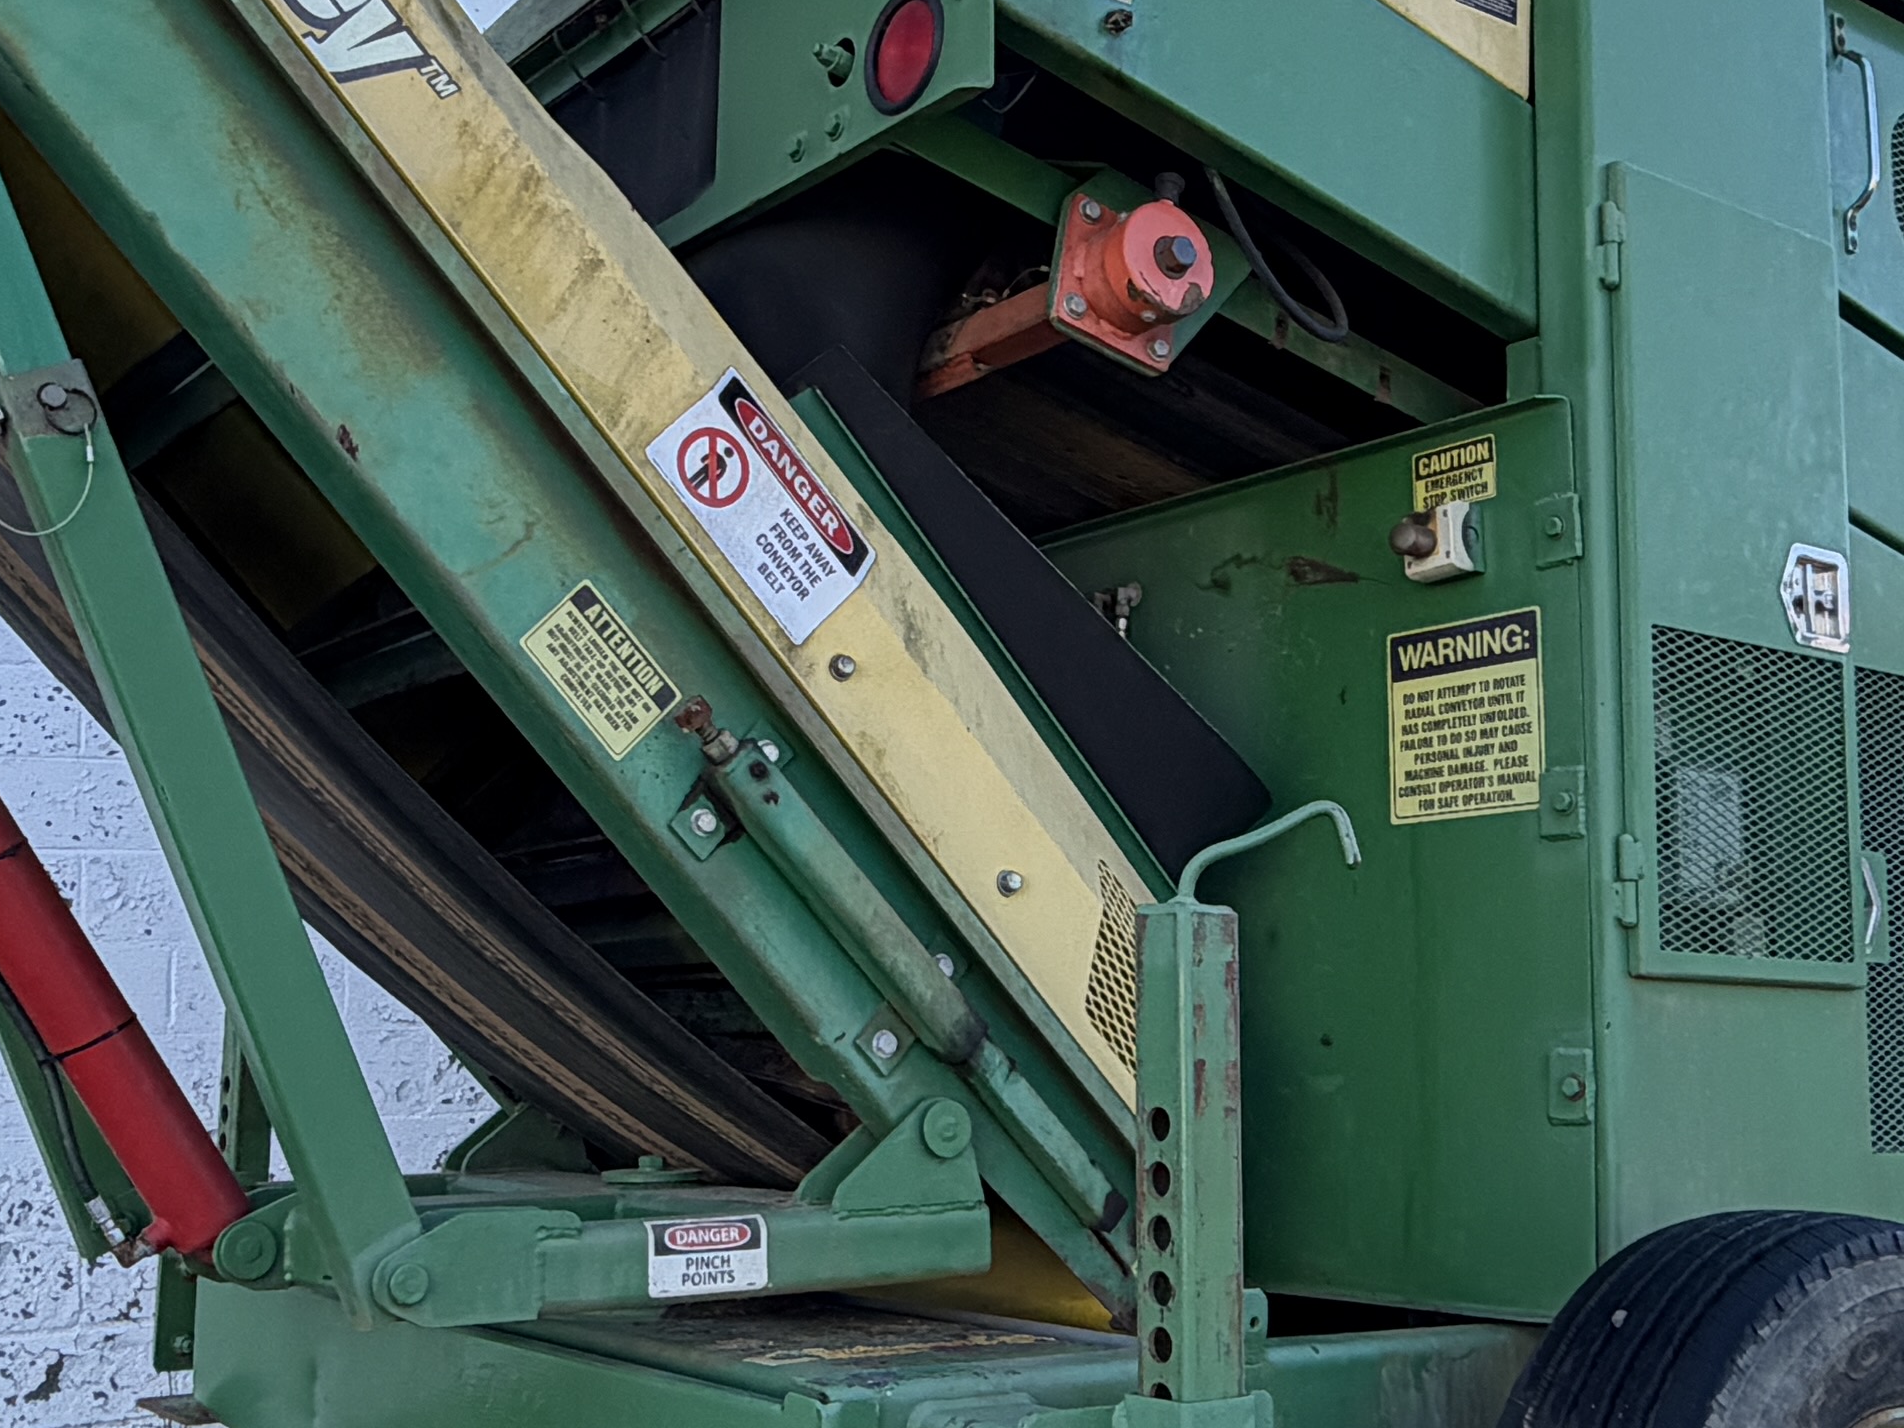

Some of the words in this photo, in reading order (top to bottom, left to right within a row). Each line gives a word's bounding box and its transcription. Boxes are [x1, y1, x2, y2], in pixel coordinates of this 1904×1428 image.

[1419, 441, 1490, 476] CAUTION
[749, 416, 839, 537] DANGER
[1425, 467, 1483, 493] EMERGENCY
[1423, 492, 1447, 509] STOP
[1450, 481, 1488, 502] SWITCH
[769, 523, 804, 554] FROM
[800, 556, 823, 588] THE
[780, 508, 809, 541] KEEP
[806, 542, 838, 578] AWAY
[755, 533, 811, 601] CONVEYOR
[757, 563, 786, 595] BELT
[583, 601, 665, 696] ATTENTION
[1398, 624, 1530, 672] WARNING:
[1403, 693, 1415, 705] DO
[1418, 690, 1434, 702] NOT
[1437, 682, 1476, 700] ATTEMPT
[1479, 680, 1490, 692] TO
[1493, 674, 1525, 690] ROTATE
[1402, 723, 1419, 736] HAS
[1422, 714, 1476, 733] COMPLETELY
[1480, 706, 1530, 724] UNFOLDED.
[1405, 705, 1435, 721] RADIAL
[1439, 697, 1485, 715] CONVEYOR
[1488, 693, 1513, 707] UNTIL
[1516, 690, 1525, 702] IT
[1400, 736, 1433, 752] FAILURE
[1437, 734, 1447, 746] TO
[1450, 732, 1462, 744] DO
[1465, 730, 1476, 742] SO
[1480, 727, 1499, 740] MAY
[1502, 721, 1532, 737] CAUSE
[1414, 748, 1460, 765] PERSONAL
[1463, 743, 1495, 758] INJURY
[1498, 740, 1518, 752] AND
[1405, 766, 1444, 782] MACHINE
[1448, 760, 1489, 776] DAMAGE.
[1494, 755, 1528, 771] PLEASE
[1399, 782, 1436, 798] CONSULT
[1439, 775, 1494, 793] OPERATOR'S
[1497, 771, 1536, 786] MANUAL
[1419, 798, 1435, 812] FOR
[1438, 796, 1459, 810] SAFE
[1462, 789, 1515, 806] OPERATION.
[675, 1227, 740, 1245] DANGER
[682, 1270, 735, 1286] POINTS
[686, 1255, 731, 1271] PINCH
